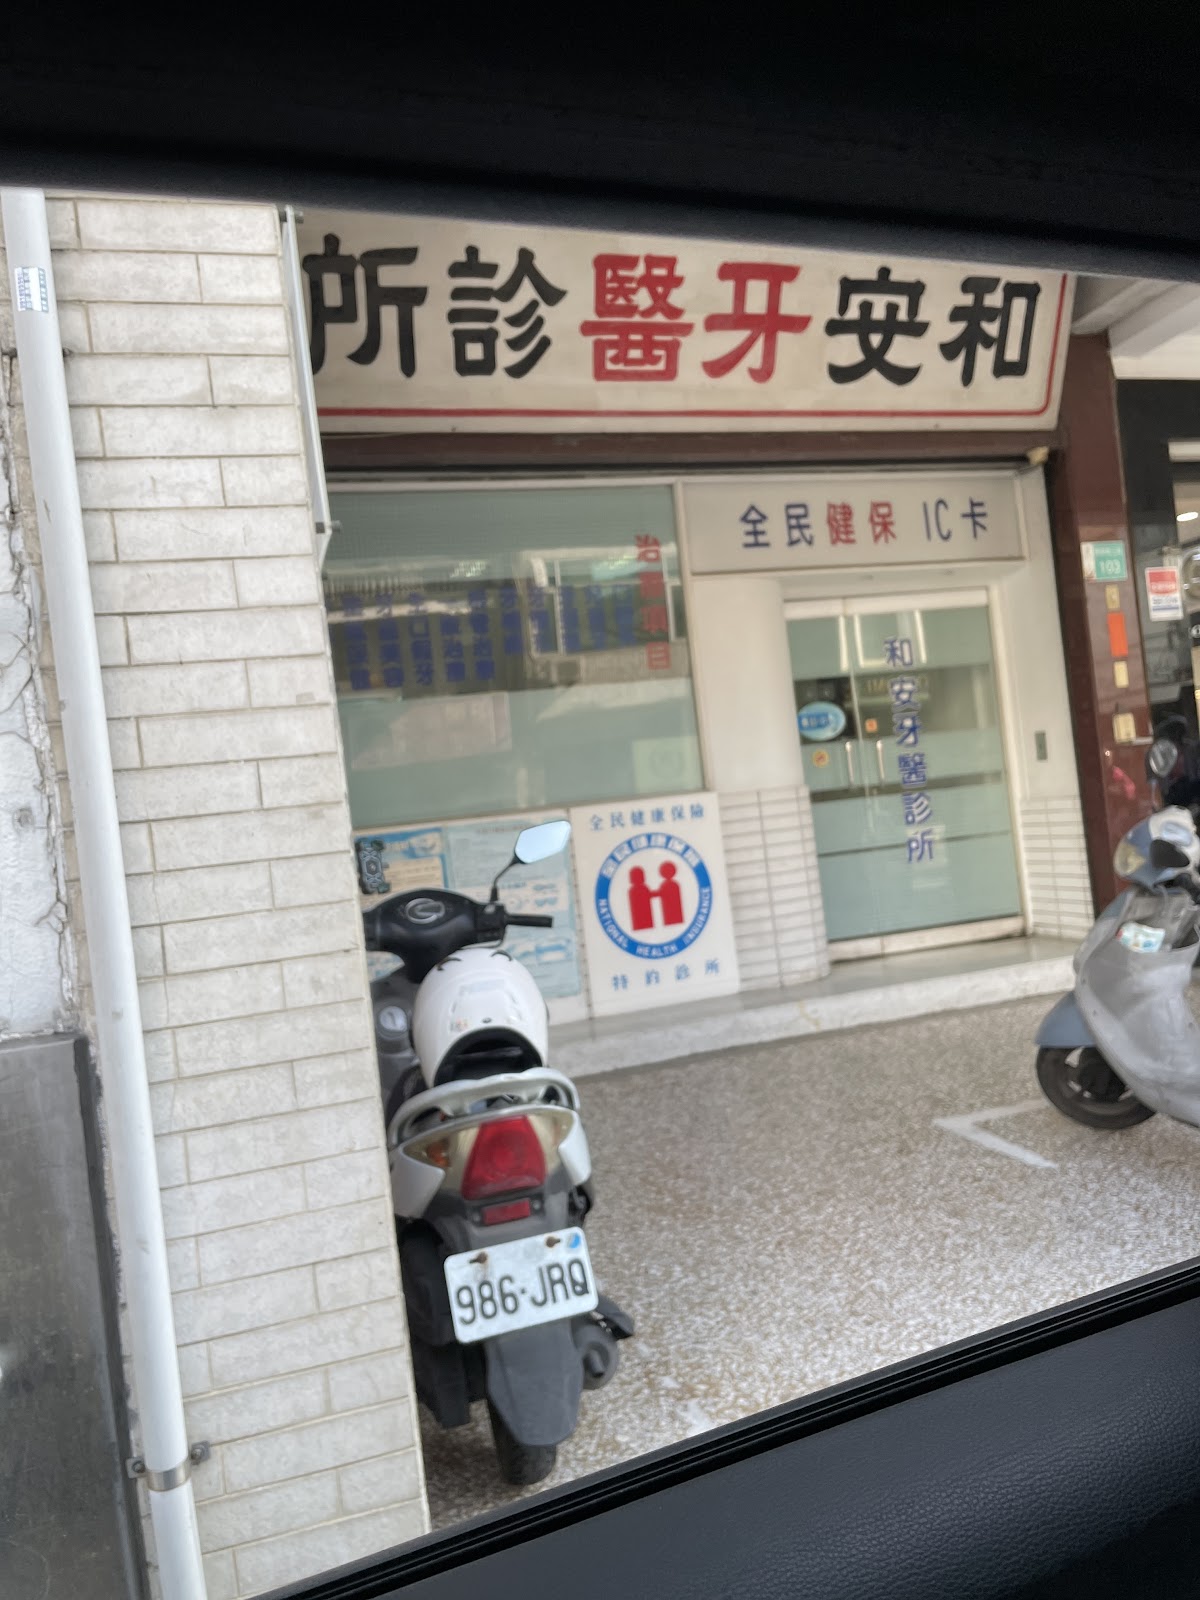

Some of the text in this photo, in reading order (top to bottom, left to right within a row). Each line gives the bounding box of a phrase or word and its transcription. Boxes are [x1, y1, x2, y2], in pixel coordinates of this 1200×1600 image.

[302, 233, 1042, 386] 和安牙醫診所
[740, 500, 897, 549] 全民健保
[883, 636, 934, 863] 和安牙醫診所
[599, 887, 711, 958] NATIONAL HEALTH INSURANCE
